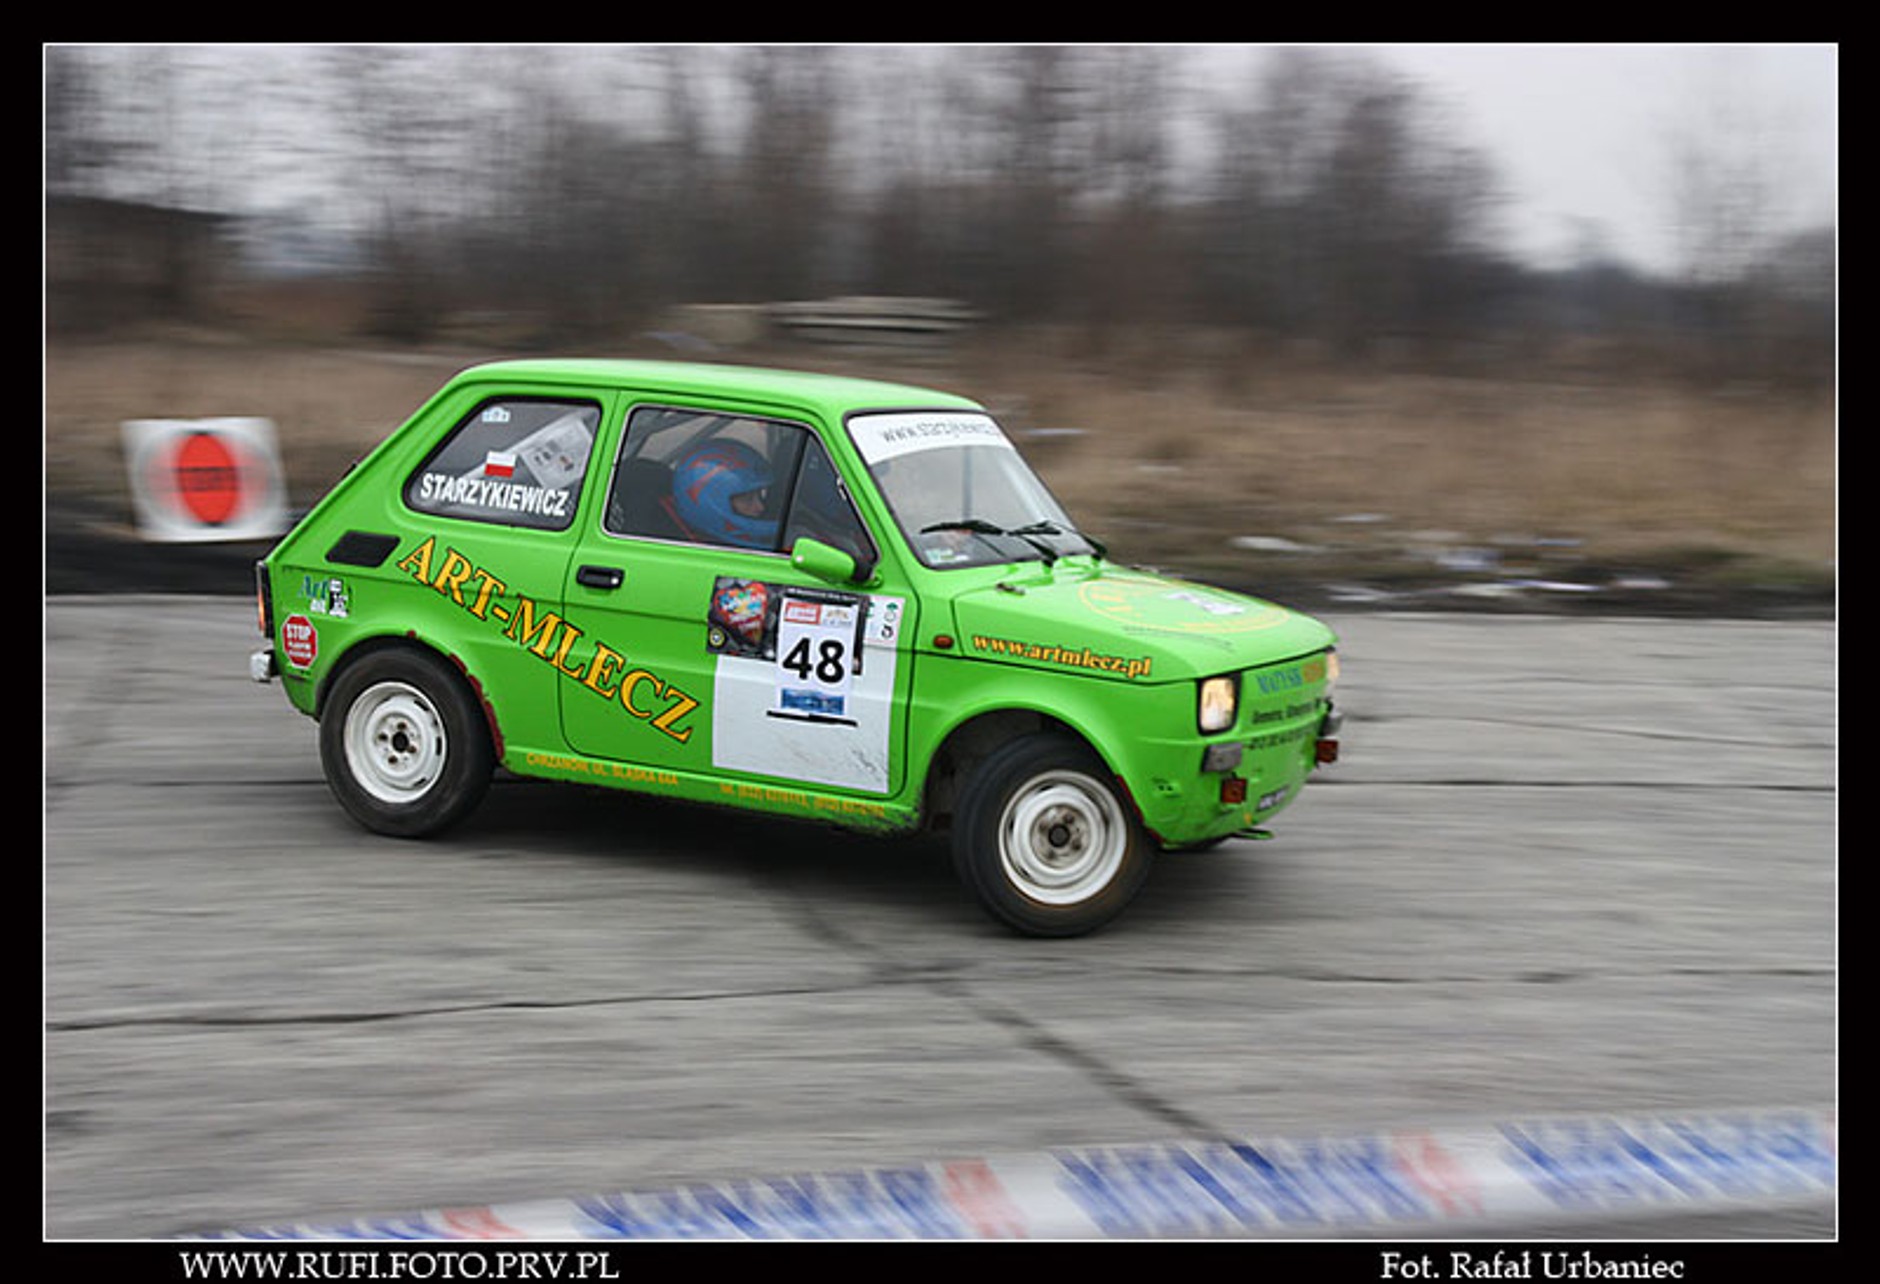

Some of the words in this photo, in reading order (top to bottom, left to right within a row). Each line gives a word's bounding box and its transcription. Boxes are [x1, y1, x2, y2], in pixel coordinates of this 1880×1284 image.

[420, 472, 570, 517] STARZYKIEWICZ
[397, 534, 701, 744] ART-MLECZ
[782, 636, 846, 685] 48
[973, 634, 1152, 679] www.artmlecz.pl
